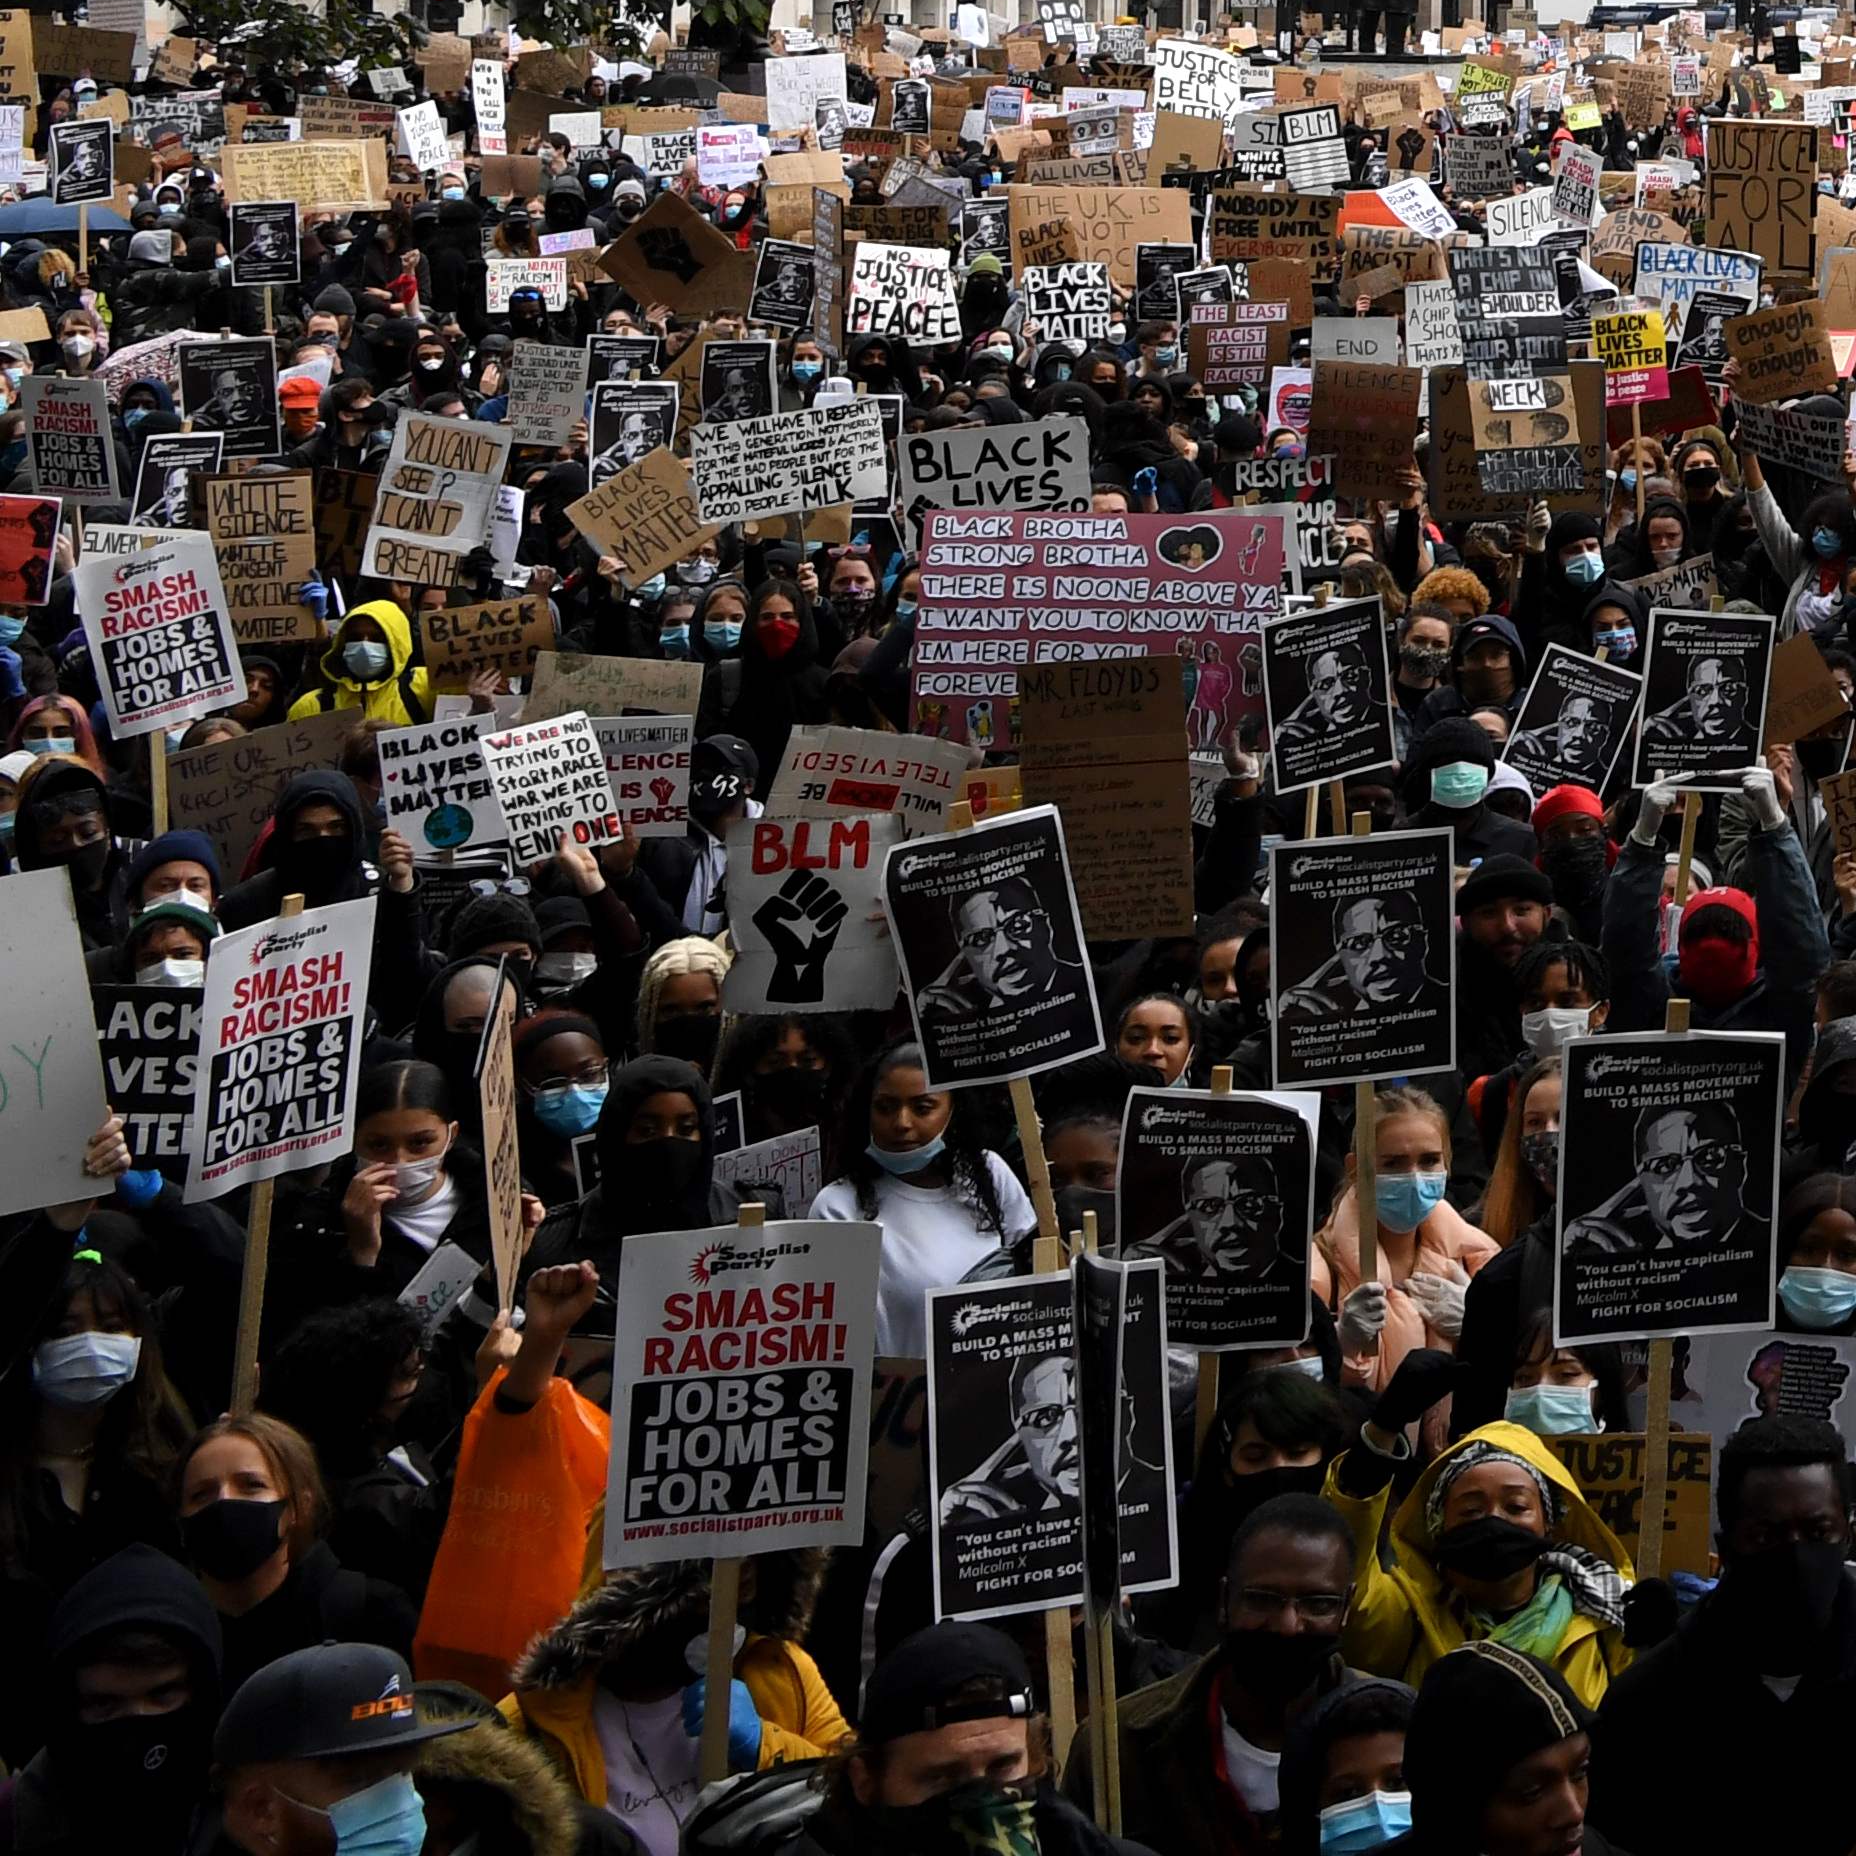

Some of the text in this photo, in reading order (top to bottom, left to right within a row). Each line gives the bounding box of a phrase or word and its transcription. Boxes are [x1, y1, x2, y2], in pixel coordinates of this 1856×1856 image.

[1289, 111, 1333, 139] BLM
[1027, 264, 1104, 293] BLACK
[1030, 287, 1109, 314] LIVES
[1194, 304, 1287, 321] THE LEAST
[1030, 312, 1112, 341] MATTER
[1208, 328, 1265, 343] RACIST
[1209, 346, 1266, 361] IS STILL
[1206, 368, 1263, 382] RACIST
[382, 724, 479, 759] BLACK
[402, 753, 482, 785] LIVES
[752, 820, 870, 875] BLM
[1290, 867, 1435, 892] BUILD A MASS MOVEMENT
[1311, 879, 1415, 900] TO SMASH RACISM
[1320, 1020, 1348, 1031] can't
[1351, 1016, 1377, 1027] have
[1379, 1009, 1437, 1024] capitalism
[1291, 1033, 1337, 1047] without
[1304, 1044, 1425, 1068] FIGHT FOR SOCIALISM
[663, 1283, 834, 1332] SMASH
[644, 1325, 847, 1375] RACISM!
[644, 1371, 839, 1426] JOBS &
[643, 1415, 834, 1472] HOMES
[628, 1461, 843, 1519] FOR ALL
[623, 1507, 844, 1541] www.socialistparty.org.uk
